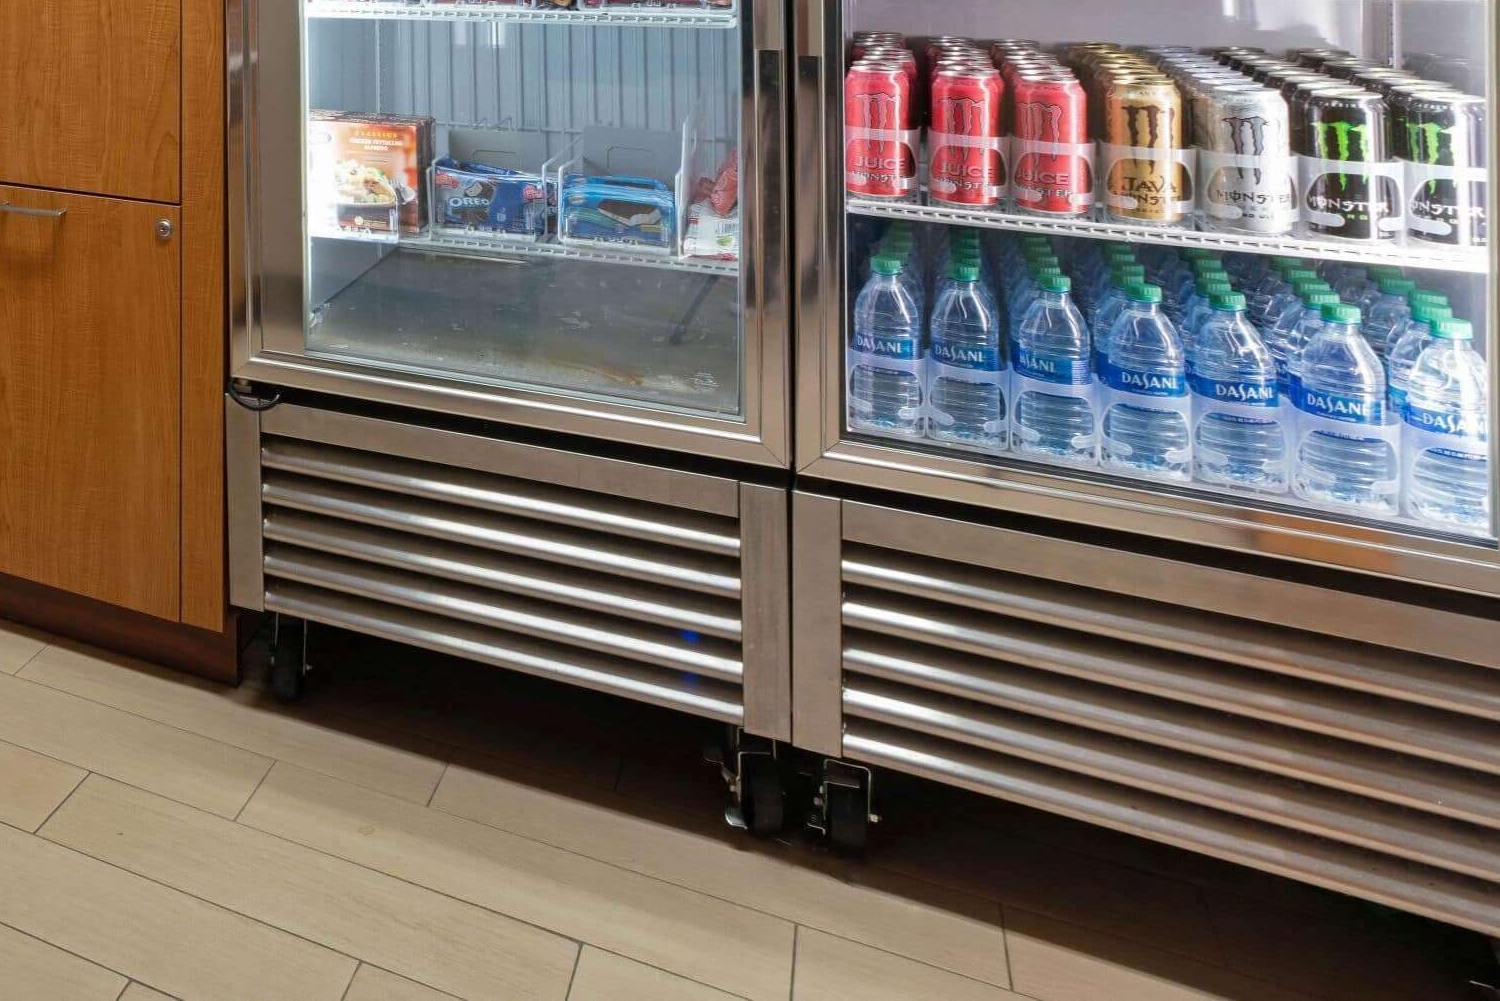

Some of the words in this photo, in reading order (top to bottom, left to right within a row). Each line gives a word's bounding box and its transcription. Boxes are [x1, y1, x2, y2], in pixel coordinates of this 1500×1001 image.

[854, 156, 906, 170] JUICE
[940, 163, 993, 178] JUICE
[449, 196, 490, 207] OREO
[856, 333, 902, 354] DASANI
[934, 343, 986, 363] DASANI
[1121, 370, 1179, 390] DASANI
[1215, 382, 1273, 401] DASANI
[1306, 393, 1370, 417] DASANI
